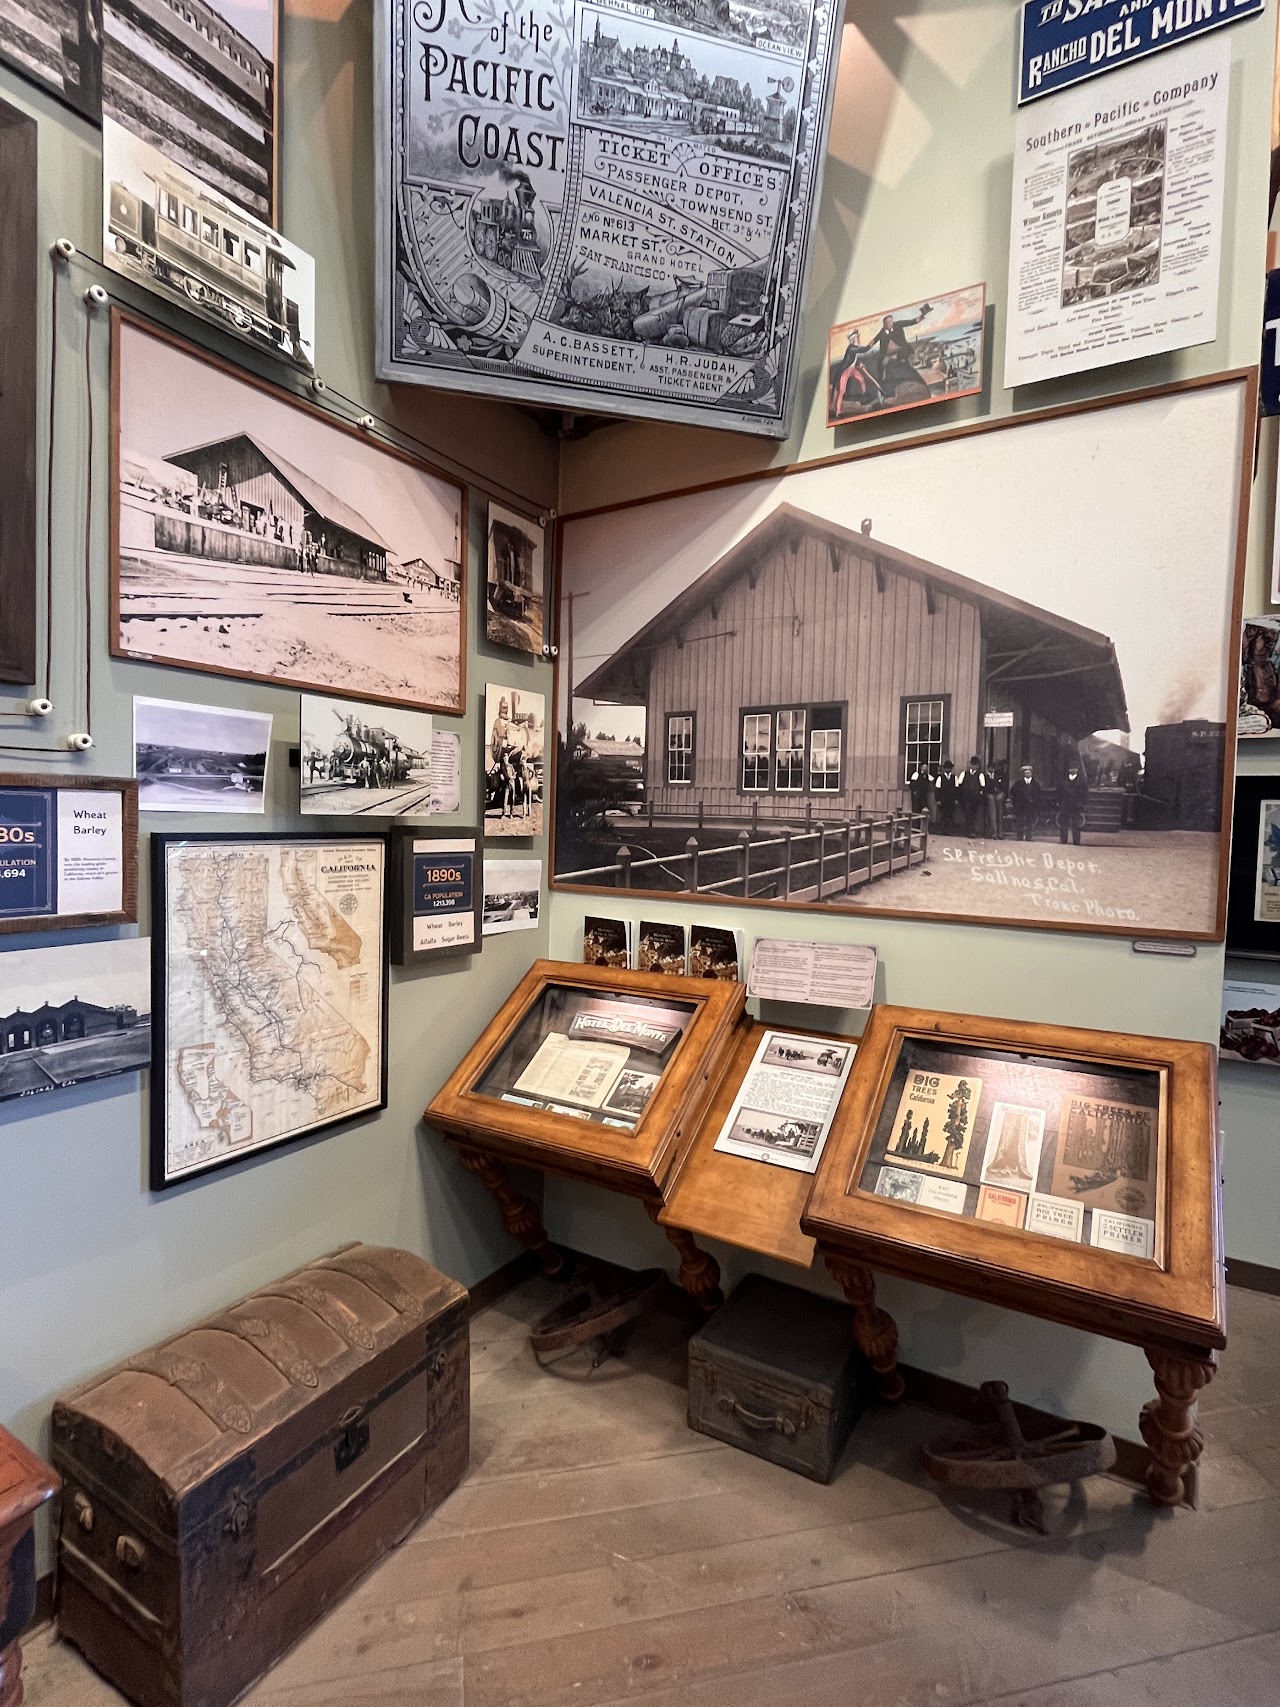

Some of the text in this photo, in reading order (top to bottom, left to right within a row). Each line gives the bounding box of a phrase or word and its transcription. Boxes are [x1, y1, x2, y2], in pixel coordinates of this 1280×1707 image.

[490, 11, 509, 55] of
[520, 9, 553, 53] the
[1028, 36, 1087, 89] RANCHO
[1090, 17, 1141, 65] DEL
[1151, 0, 1251, 41] MONTE
[418, 40, 556, 112] PACIFIC
[1025, 71, 1219, 153] Southern Pacific Company
[458, 114, 566, 174] COAST.
[599, 139, 672, 167] TICKET
[607, 163, 744, 207] PASSENGER DEPOT,
[679, 197, 774, 229] TOWNSEND ST.
[588, 184, 738, 268] VALENCIA ST. STATION,
[616, 218, 636, 233] 613
[580, 226, 663, 254] MARKET ST.
[626, 250, 705, 274] GRAND HOTEL
[532, 344, 636, 374] SUPERINTENDENT.
[657, 375, 691, 389] TICKET
[671, 367, 724, 383] PASSENGER
[73, 809, 107, 820] Wheat
[73, 825, 107, 837] Barley
[968, 849, 1036, 868] Freight
[321, 864, 378, 874] CALIFORNIA
[426, 868, 462, 883] 1890s
[420, 938, 437, 946] Alfalfa
[441, 935, 456, 944] Sugar
[574, 1016, 668, 1042] HOTEL DEL MONTE
[913, 1074, 941, 1088] BIG
[912, 1085, 938, 1096] TREES
[909, 1093, 936, 1105] California
[987, 1192, 1017, 1205] CALIFORNIA
[1036, 1203, 1075, 1214] CALIFORNIA
[1036, 1207, 1074, 1220] BIG TREE
[1035, 1214, 1073, 1226] PRIMER
[1103, 1218, 1143, 1231] CALIFORNIA
[1103, 1229, 1143, 1244] PRIMER
[1108, 1225, 1144, 1238] SETTLER
